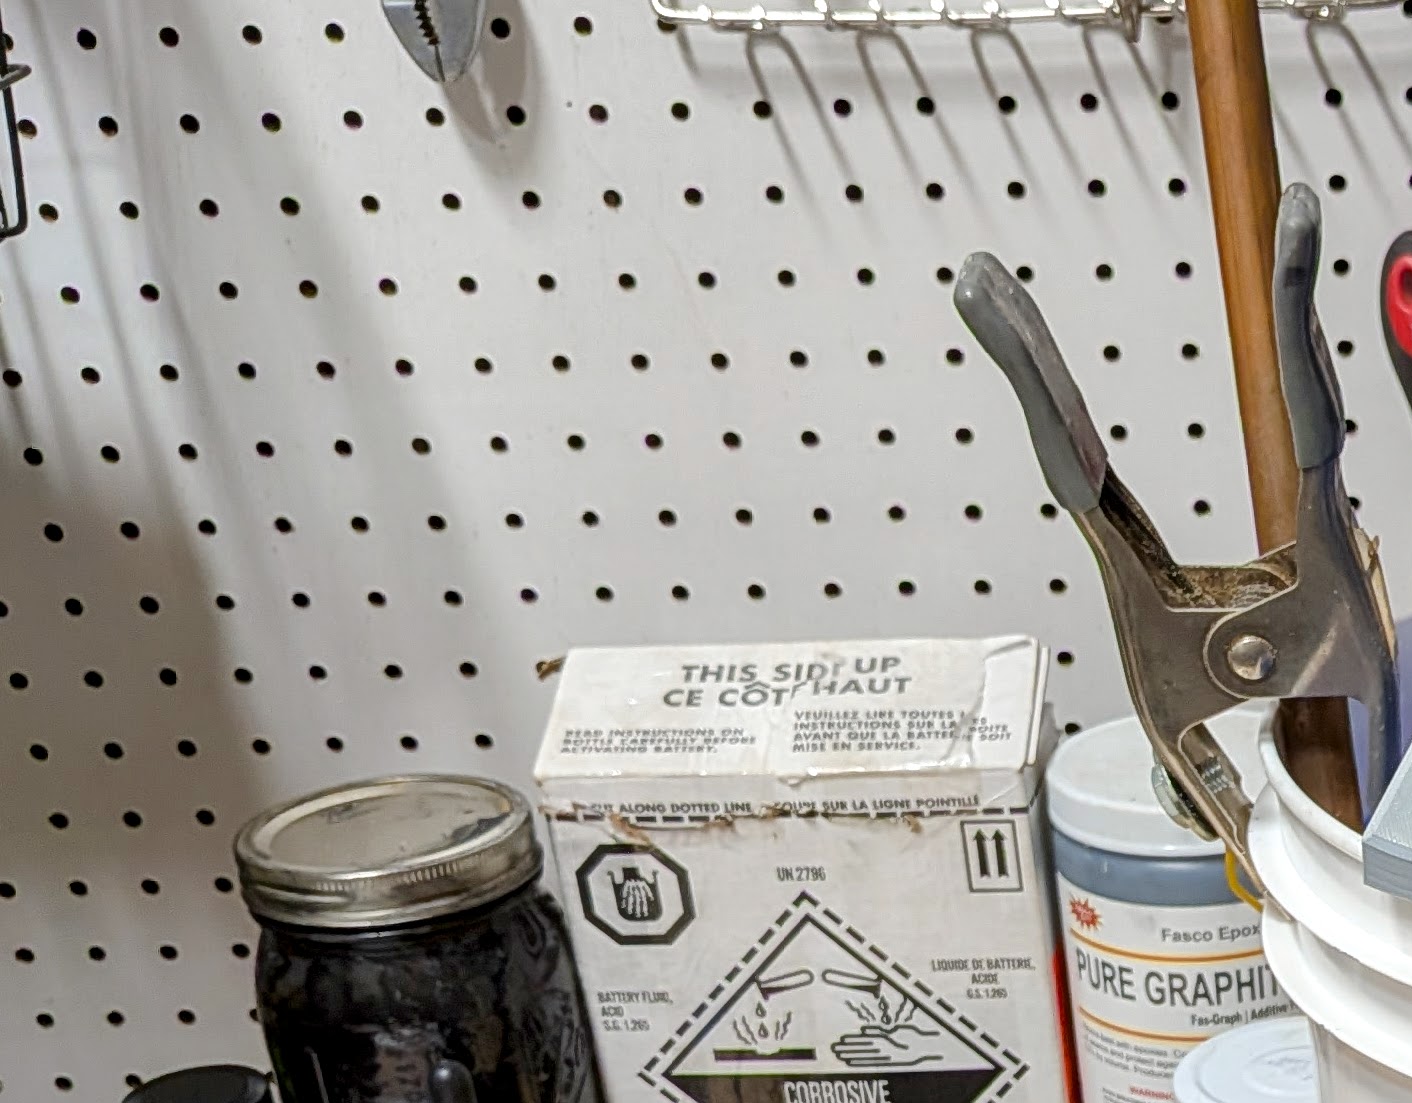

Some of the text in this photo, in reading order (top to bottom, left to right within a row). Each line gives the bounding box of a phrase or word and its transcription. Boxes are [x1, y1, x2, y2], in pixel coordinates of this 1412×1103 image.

[682, 664, 758, 683] THIS
[855, 657, 902, 674] UP
[663, 689, 704, 707] CE
[814, 677, 913, 695] HAUT
[793, 732, 839, 741] AVANT
[793, 743, 825, 753] MISE
[832, 742, 851, 751] EN
[620, 804, 665, 813] ALONG
[671, 803, 720, 813] DOTTED
[724, 803, 751, 812] LINE
[822, 801, 847, 810] SUR
[852, 801, 868, 809] LA
[873, 799, 910, 809] LIGNE
[777, 867, 826, 881] UN 2796
[1161, 926, 1260, 943] Fasco Epox
[931, 959, 970, 971] LIQUIDE
[972, 959, 985, 970] DE
[971, 974, 998, 985] ACIDE
[1076, 946, 1278, 1007] PURE GRAPHIT
[597, 992, 640, 1003] BATTERY
[602, 1006, 624, 1017] ACID
